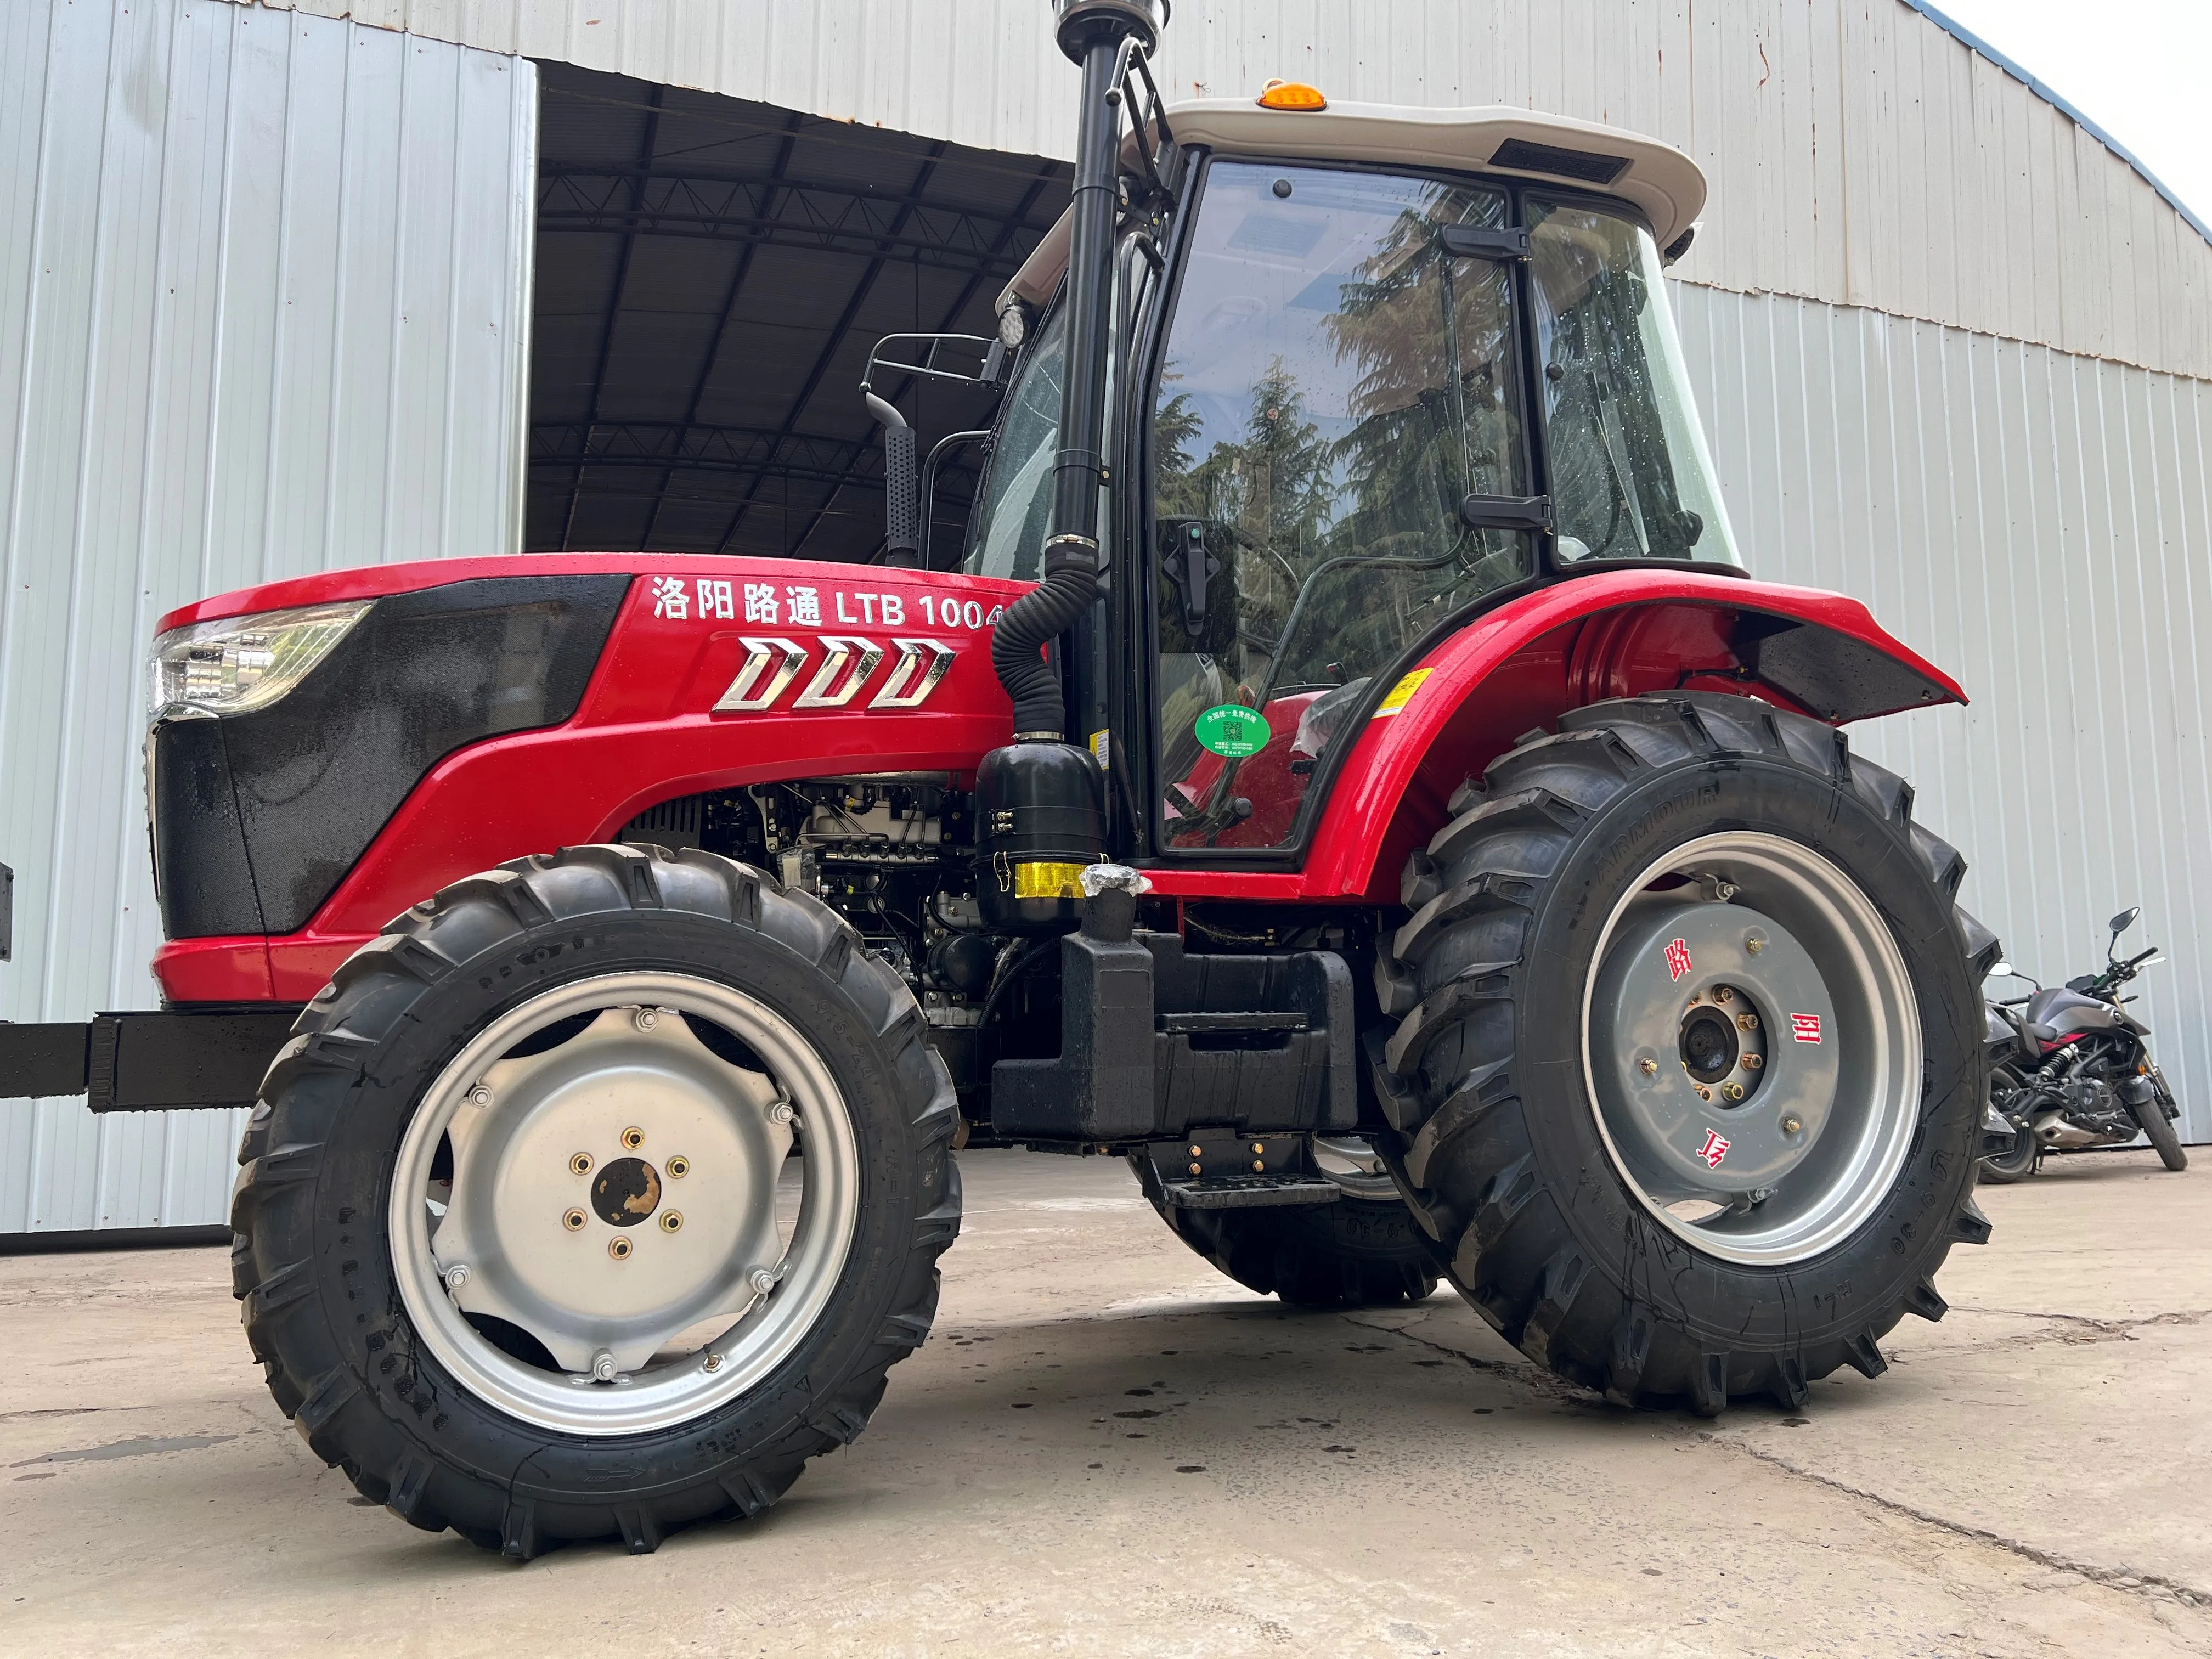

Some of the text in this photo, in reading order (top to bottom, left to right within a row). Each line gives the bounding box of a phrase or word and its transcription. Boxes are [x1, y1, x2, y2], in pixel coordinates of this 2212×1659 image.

[652, 576, 822, 627] 洛阳路通
[836, 591, 905, 626] LTB
[1207, 709, 1257, 724] 全国统一免费热线
[1595, 783, 1719, 886] ARMOUR
[1664, 938, 1691, 982] 路
[816, 1000, 877, 1079] 9.5-24
[1790, 1013, 1821, 1045] 阳
[1697, 1128, 1730, 1169] 红
[885, 1155, 900, 1204] R-1
